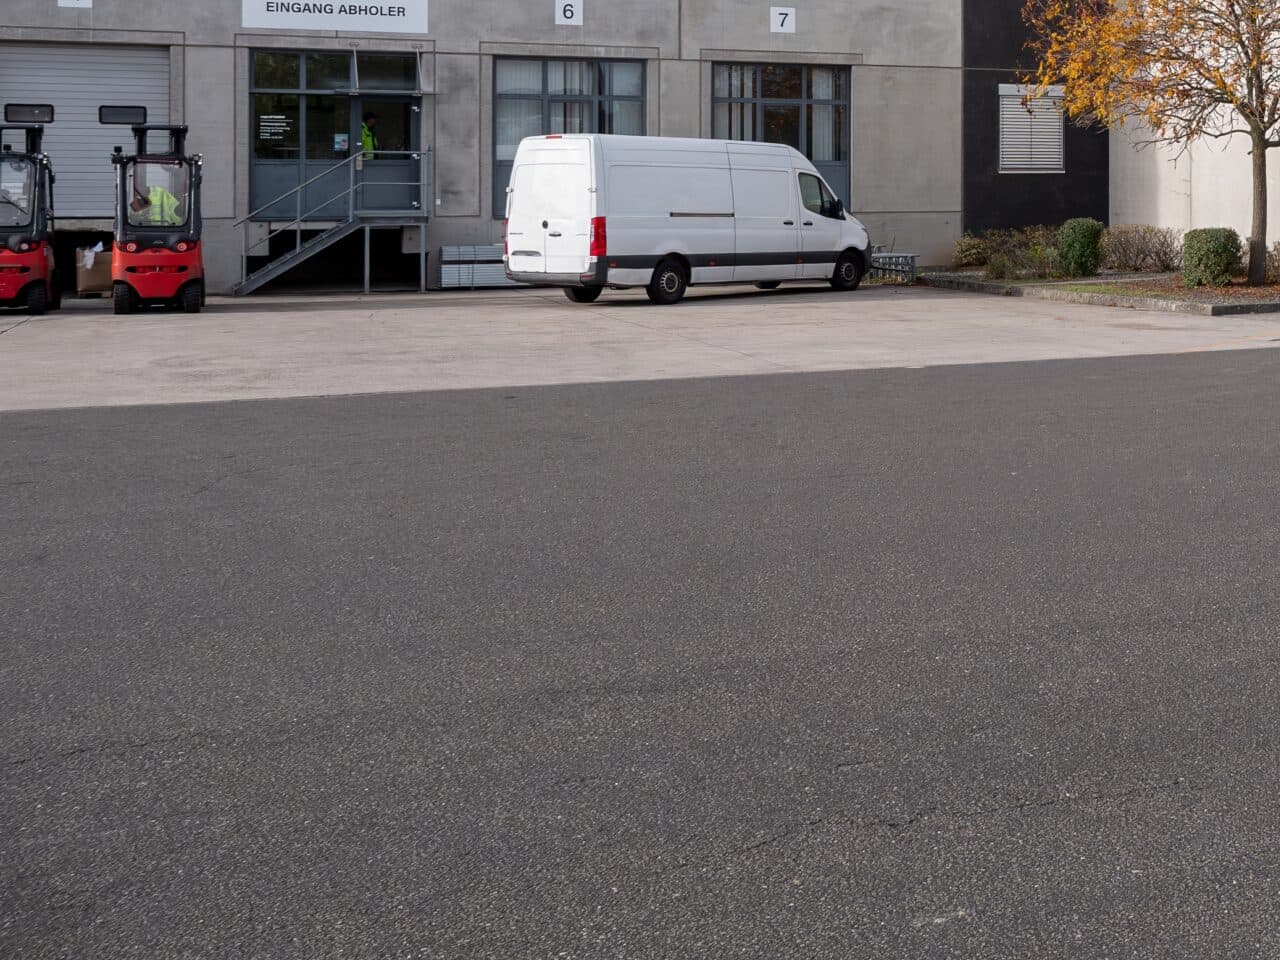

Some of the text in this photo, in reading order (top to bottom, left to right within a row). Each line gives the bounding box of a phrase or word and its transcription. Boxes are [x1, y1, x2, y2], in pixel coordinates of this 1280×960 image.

[265, 1, 406, 17] EINGANG ABHOLER
[562, 3, 575, 20] 6
[777, 12, 789, 27] 7
